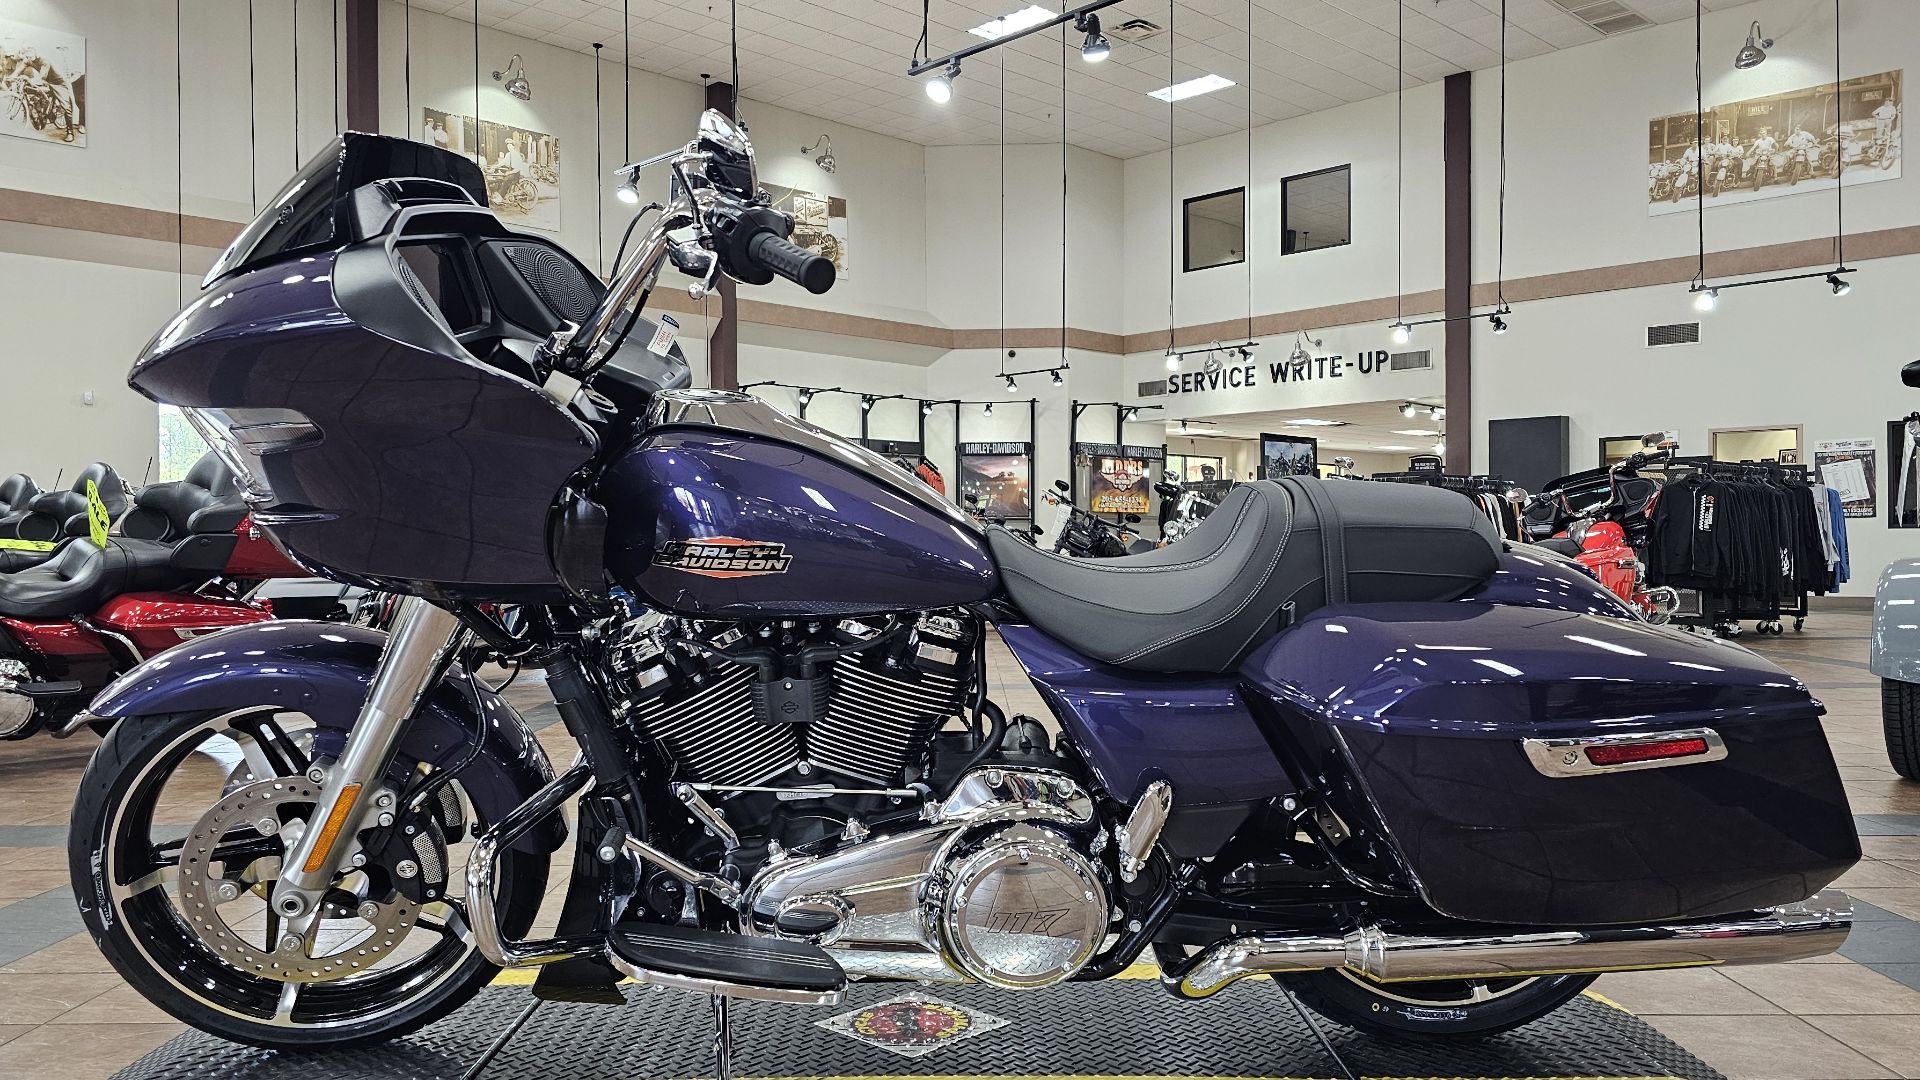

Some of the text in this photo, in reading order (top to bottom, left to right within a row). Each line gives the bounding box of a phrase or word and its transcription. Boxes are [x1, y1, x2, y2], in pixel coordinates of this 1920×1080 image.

[1168, 349, 1390, 394] SERVICE WRITE-UP
[965, 443, 1026, 454] HARLEY-DAVIDSON
[987, 908, 1070, 933] 117
